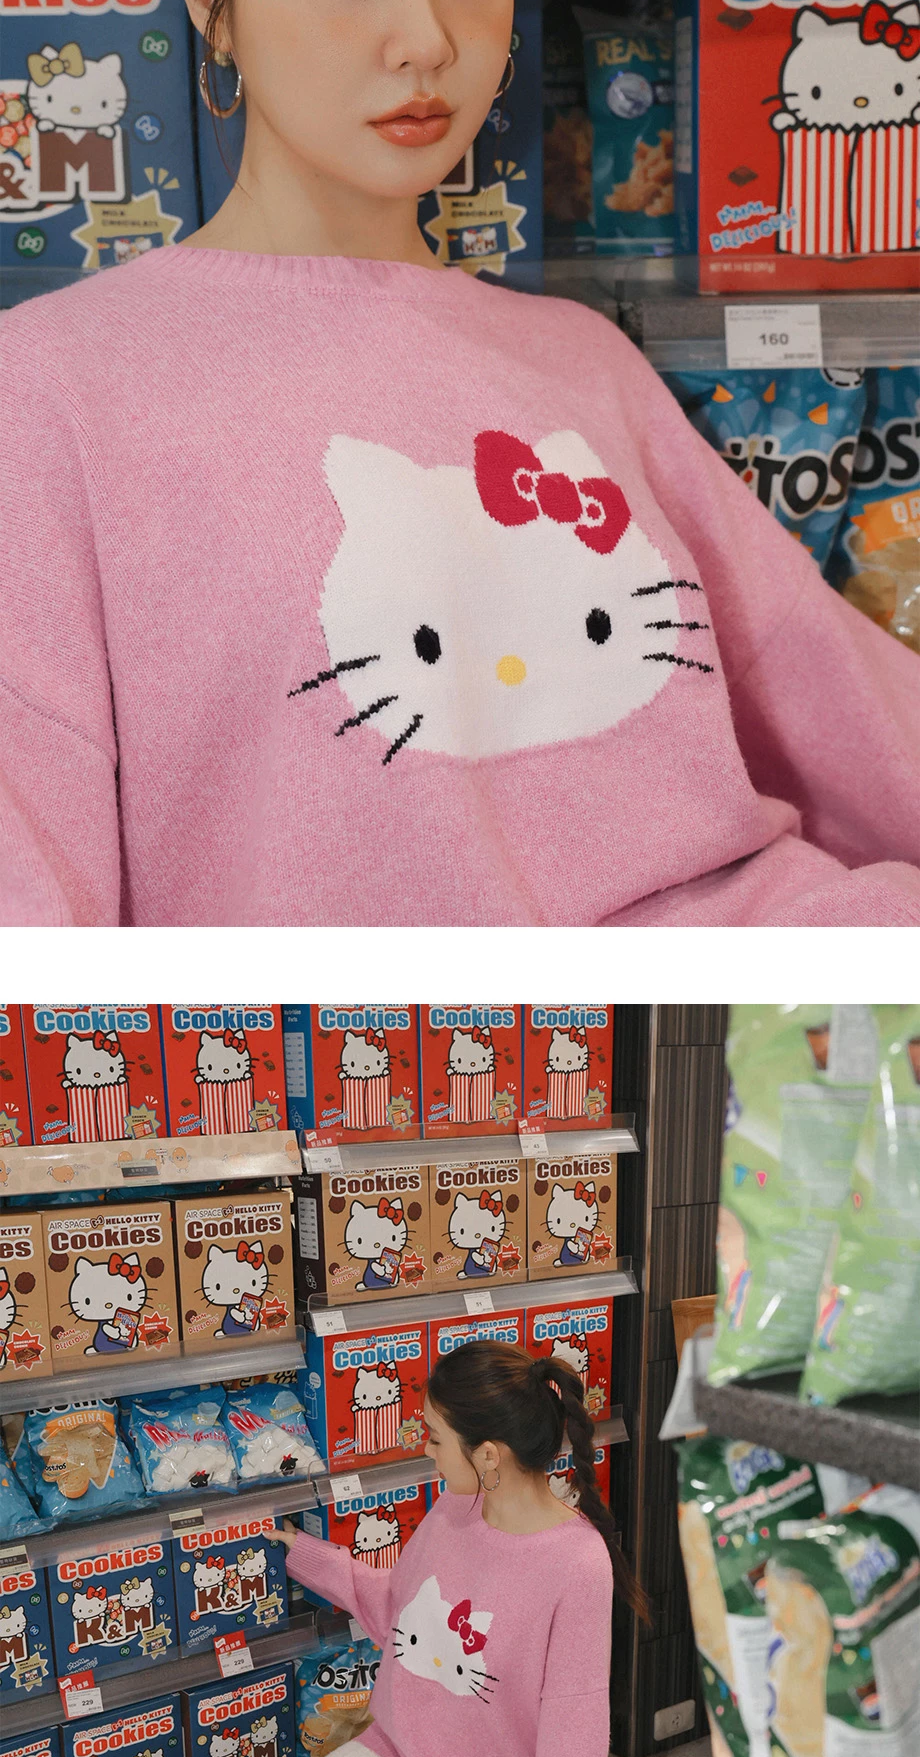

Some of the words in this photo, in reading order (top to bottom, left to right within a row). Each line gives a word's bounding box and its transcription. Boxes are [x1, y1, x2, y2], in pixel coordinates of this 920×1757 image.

[759, 333, 789, 346] 160
[35, 1010, 149, 1031] Cookies
[174, 1010, 274, 1030] Cookies
[320, 1009, 409, 1029] Cookies
[536, 1159, 610, 1179] Cookies
[332, 1175, 420, 1196] Cookies
[235, 1206, 257, 1214] HELLO
[259, 1204, 281, 1212] KITTY
[49, 1221, 63, 1229] AIR
[64, 1220, 90, 1229] SPACE
[105, 1216, 131, 1225] HELLO
[133, 1214, 160, 1223] KITTY
[188, 1216, 282, 1239] Cookies
[51, 1227, 161, 1252] Cookies
[334, 1341, 421, 1368] Cookies
[182, 1517, 275, 1550] Cookies
[59, 1544, 162, 1580] Cookies
[198, 1577, 265, 1614] K&M
[76, 1606, 151, 1646] K&M
[199, 1685, 286, 1725] Cookies
[75, 1718, 173, 1757] Cookies
